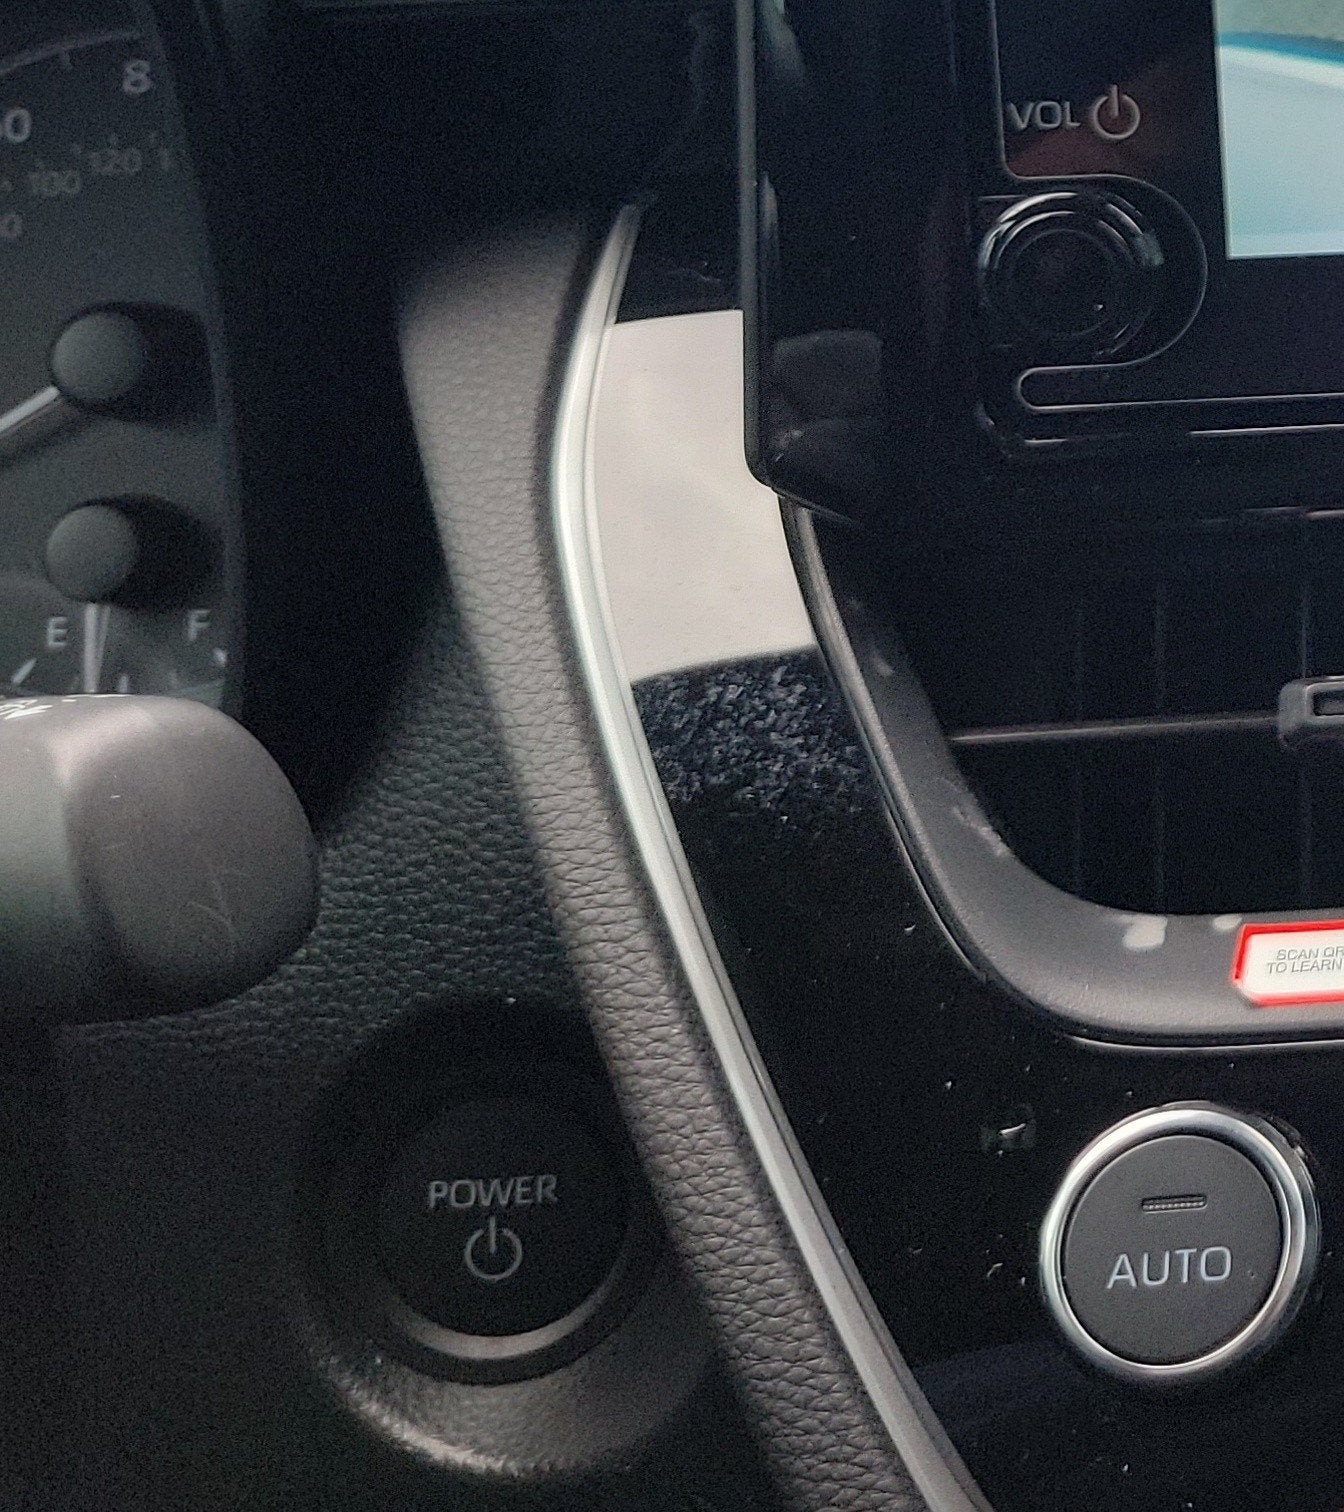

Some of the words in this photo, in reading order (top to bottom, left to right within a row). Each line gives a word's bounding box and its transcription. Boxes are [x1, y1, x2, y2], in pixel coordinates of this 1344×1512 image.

[1007, 100, 1082, 130] VOL
[46, 615, 68, 650] E
[187, 608, 211, 642] F
[1266, 961, 1288, 975] TO
[1290, 957, 1343, 974] LEARN
[1276, 946, 1319, 961] SCAN
[428, 1173, 559, 1210] POWER
[1106, 1244, 1233, 1290] AUTO
